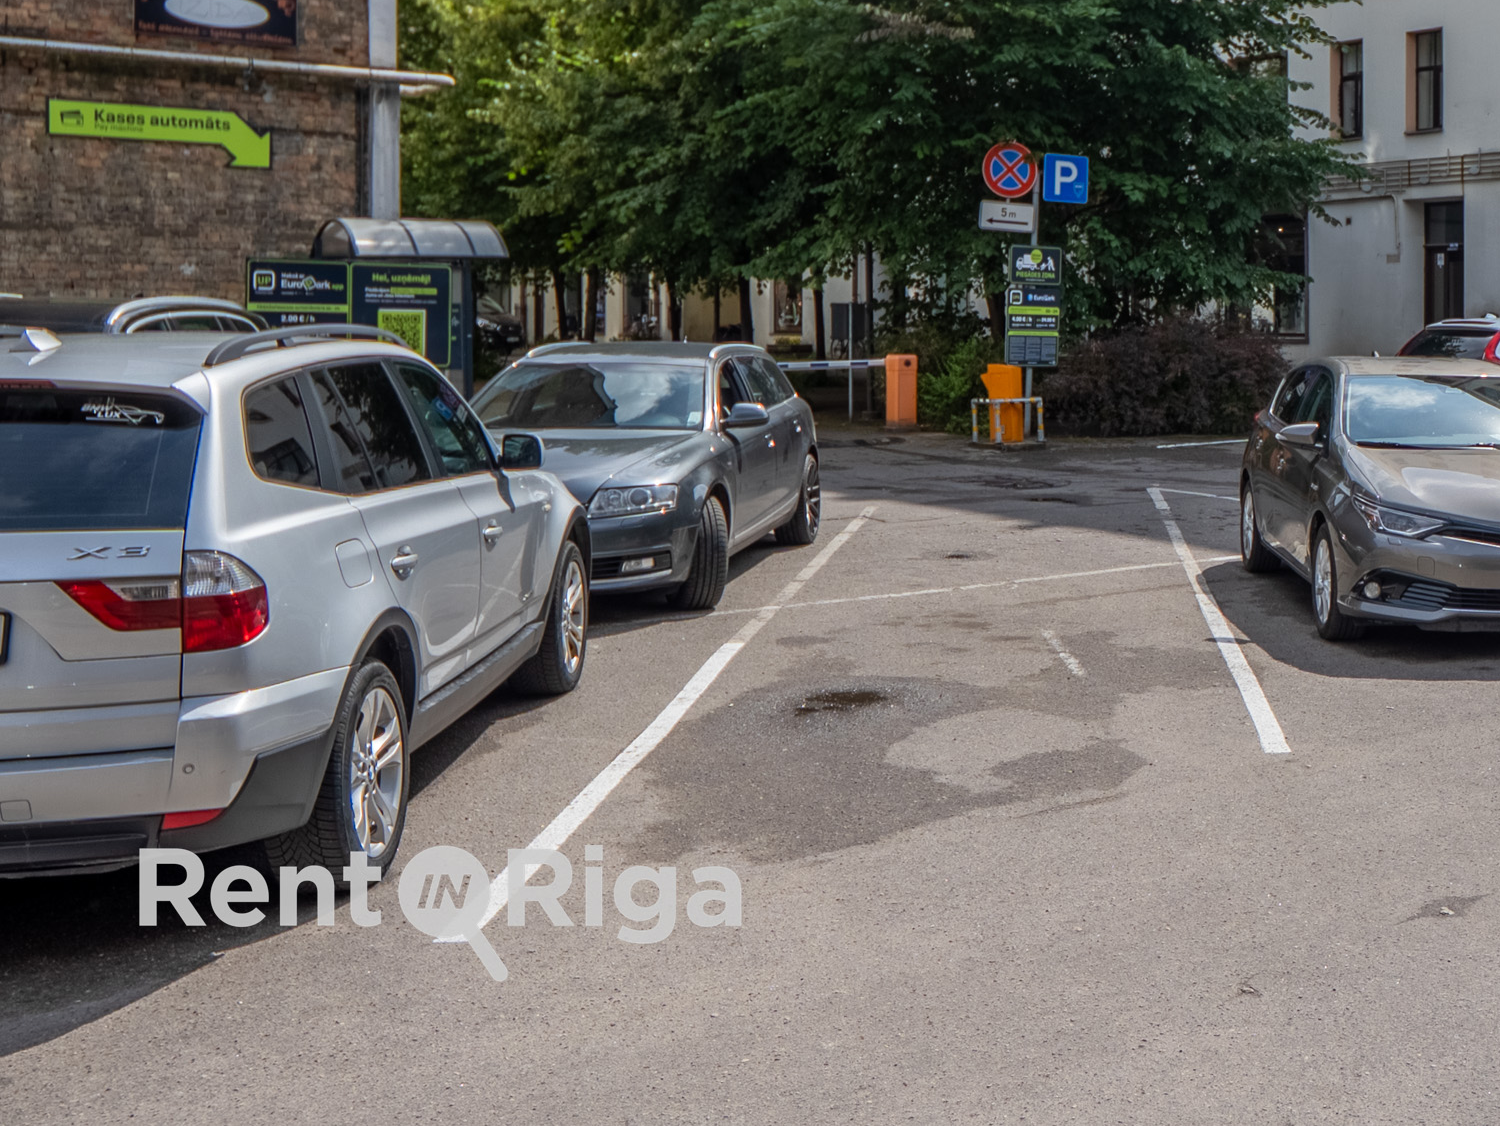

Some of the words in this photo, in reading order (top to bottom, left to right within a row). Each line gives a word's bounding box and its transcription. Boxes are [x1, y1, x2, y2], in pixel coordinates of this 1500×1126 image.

[94, 109, 145, 125] Kases
[150, 115, 231, 131] automāts
[1054, 160, 1078, 196] P
[1001, 207, 1008, 218] 5
[97, 410, 120, 419] LUX
[66, 545, 151, 561] X3
